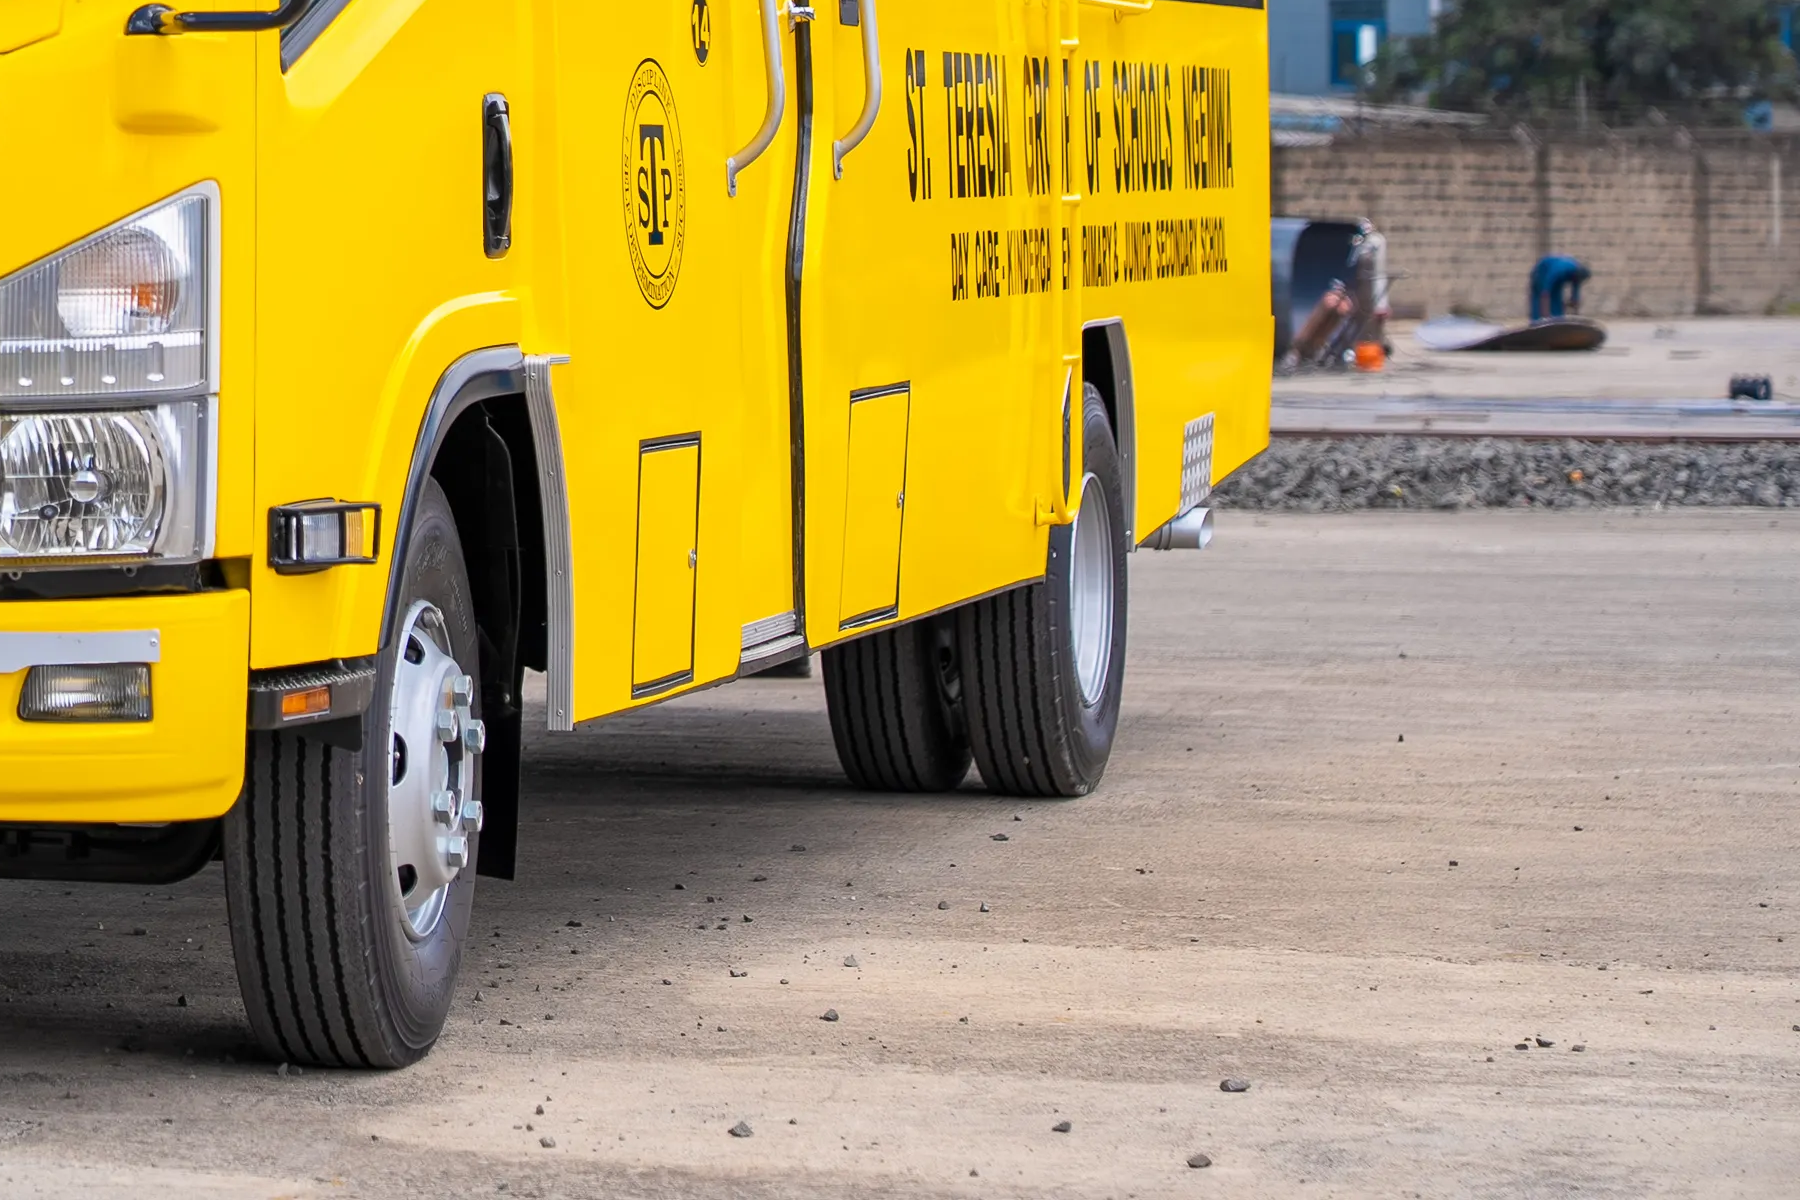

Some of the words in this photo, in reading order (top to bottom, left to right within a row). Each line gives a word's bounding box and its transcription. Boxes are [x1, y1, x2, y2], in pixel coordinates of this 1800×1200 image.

[691, 5, 711, 50] 14
[630, 69, 671, 115] DISCIPLINE
[905, 47, 932, 202] ST.
[942, 51, 1013, 199] TERESIA
[1023, 54, 1070, 197] GROP
[1084, 59, 1101, 196] OF
[1113, 60, 1173, 194] SCHOOLS
[950, 232, 970, 301] DAY
[975, 230, 1000, 299] CARE
[1123, 220, 1153, 284] JUNIOR
[1155, 218, 1198, 279] SECONDARY
[1200, 216, 1228, 274] SCHOOL
